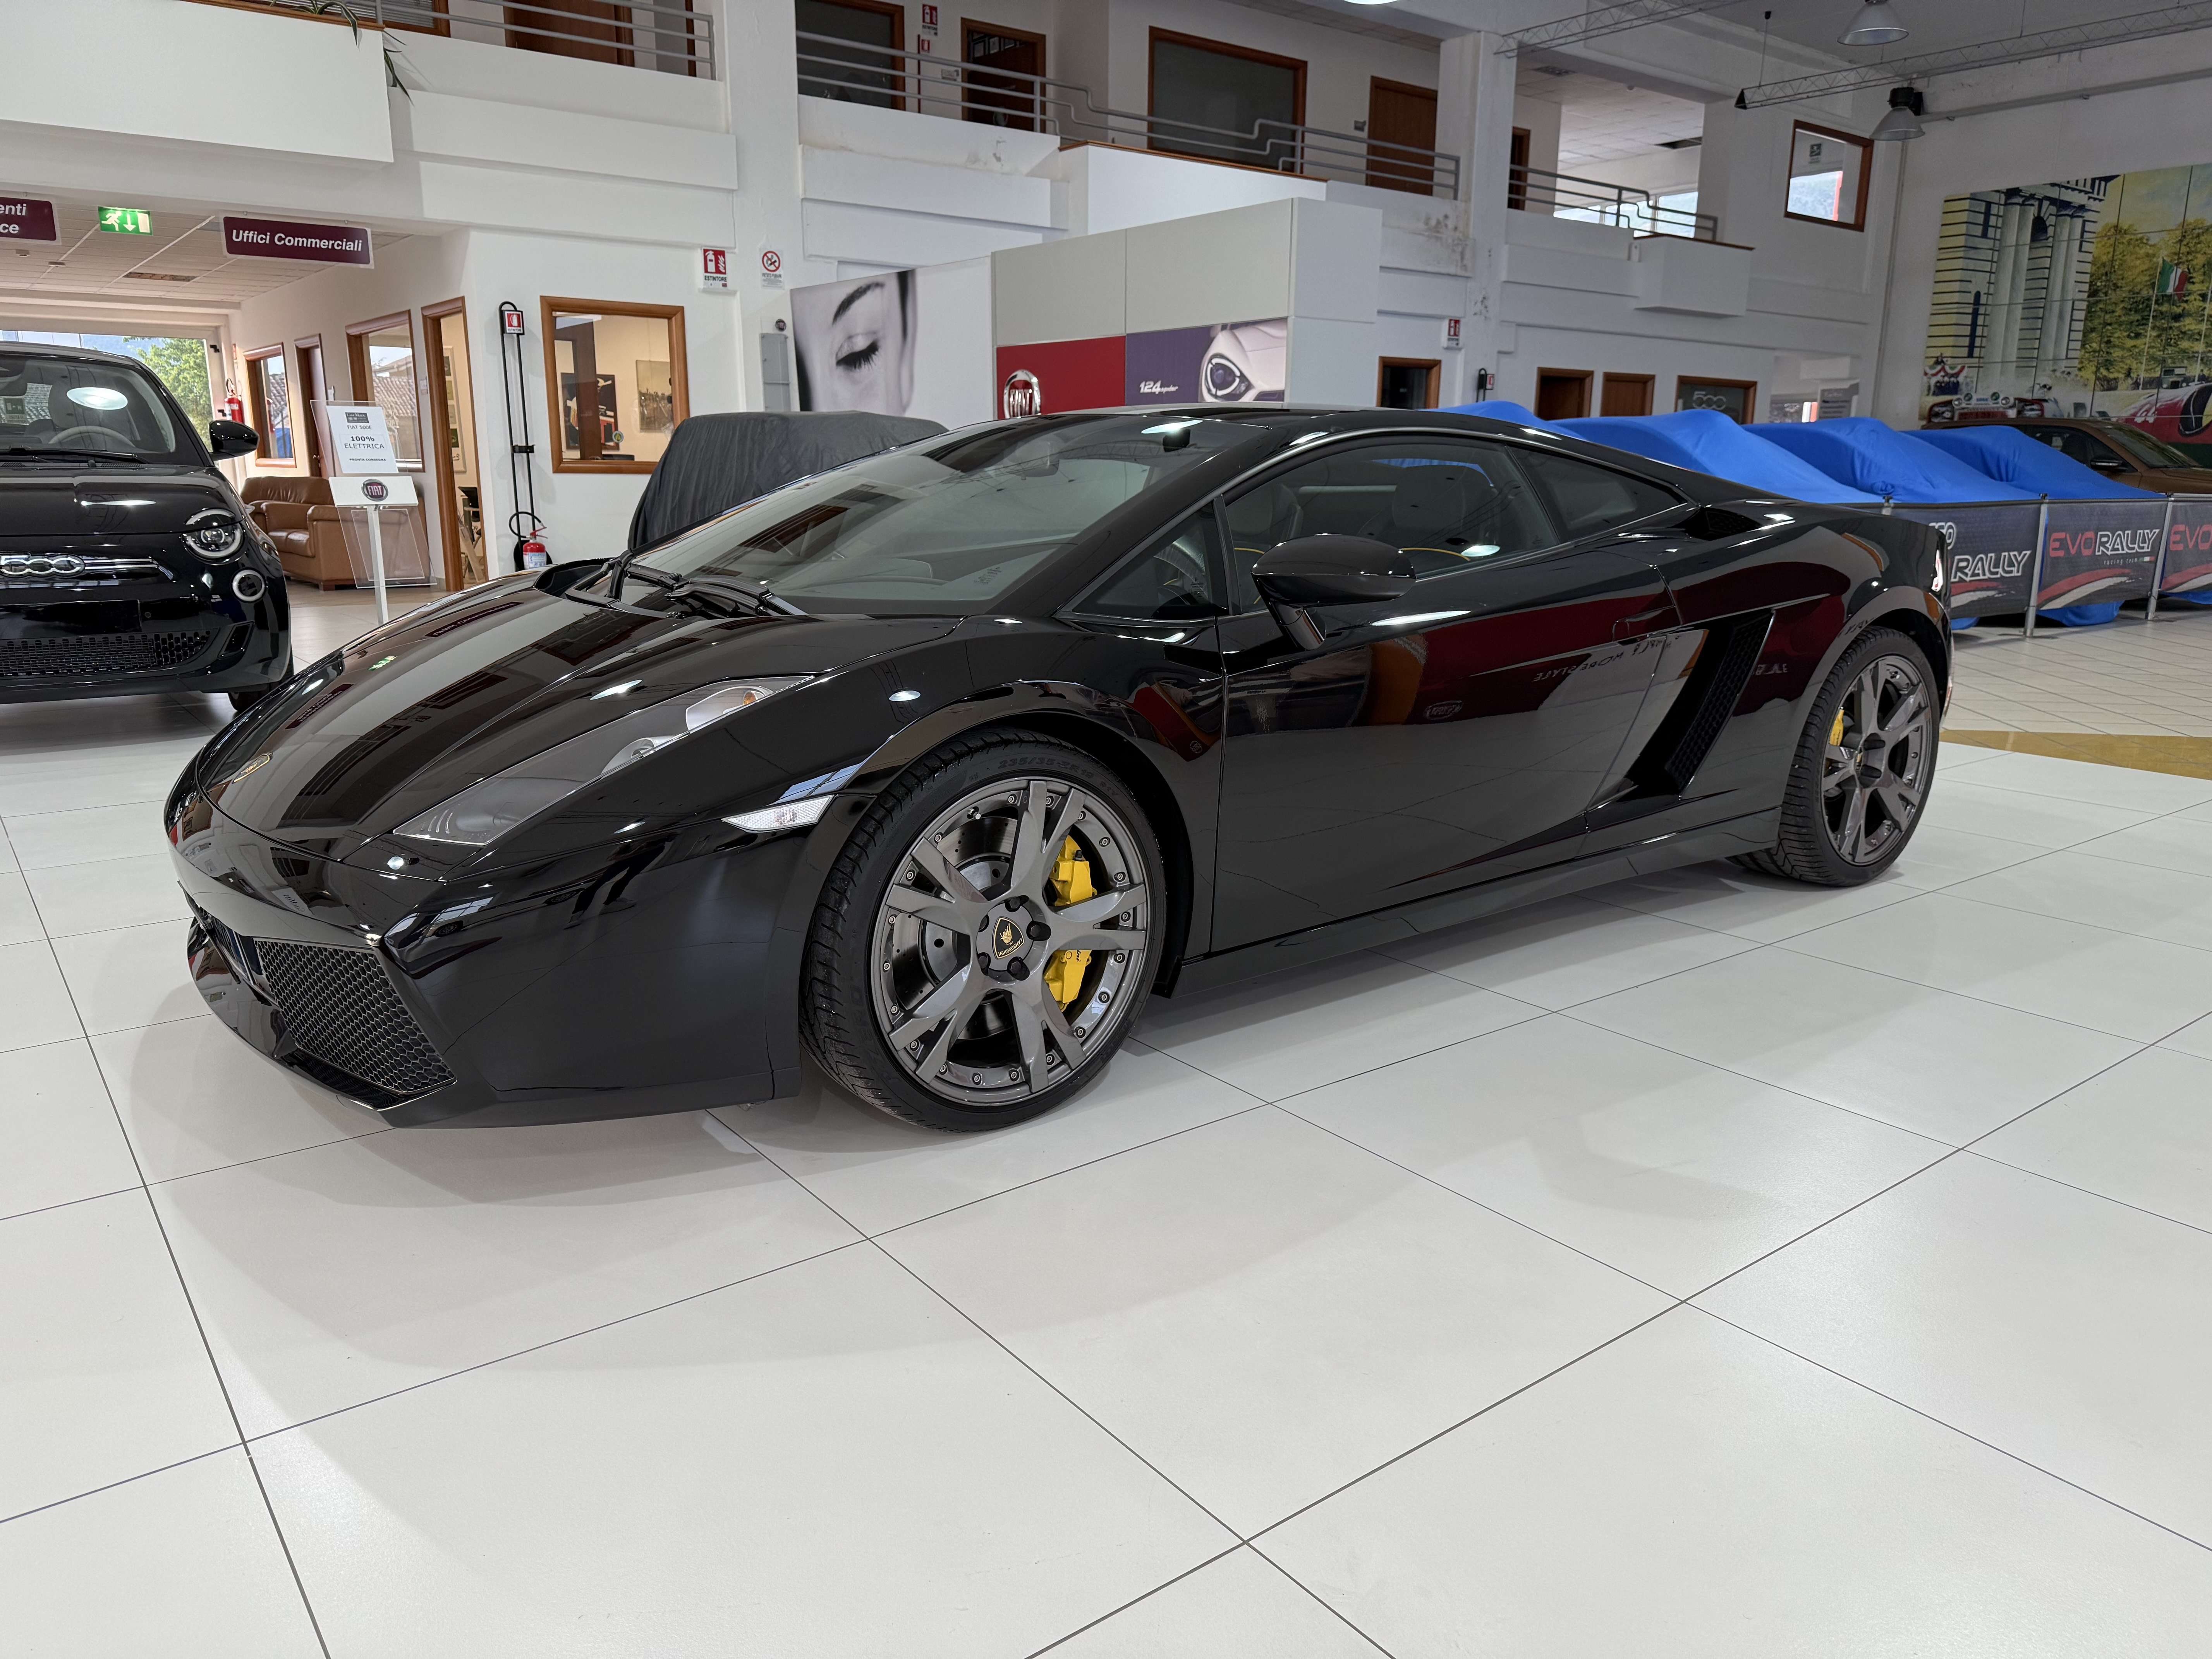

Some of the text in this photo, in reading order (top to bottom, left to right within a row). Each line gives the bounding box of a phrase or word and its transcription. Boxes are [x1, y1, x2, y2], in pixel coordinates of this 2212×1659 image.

[0, 204, 26, 215] enti
[0, 223, 19, 234] ce
[232, 230, 362, 251] Uffici Commerciali
[1010, 389, 1032, 417] FIAT
[1692, 391, 1727, 410] 500
[367, 485, 382, 496] FIAT
[2169, 524, 2212, 551] EVO
[0, 555, 81, 575] 500
[998, 938, 1023, 957] LAMBORGHINI
